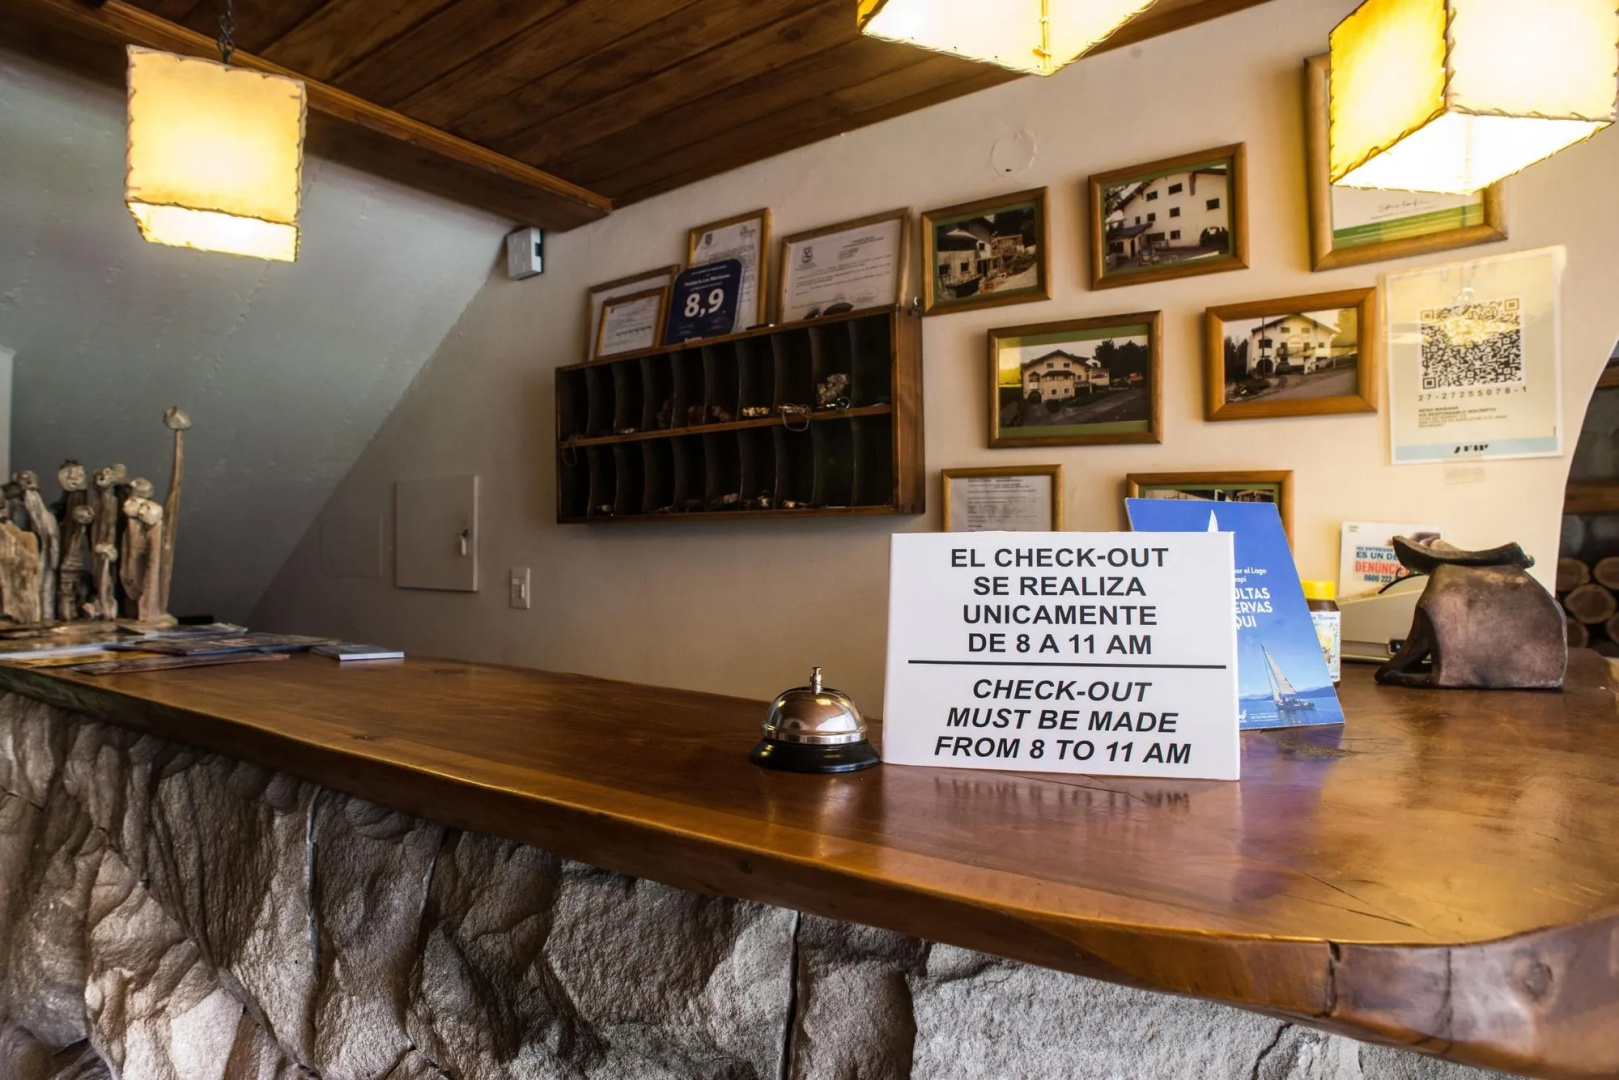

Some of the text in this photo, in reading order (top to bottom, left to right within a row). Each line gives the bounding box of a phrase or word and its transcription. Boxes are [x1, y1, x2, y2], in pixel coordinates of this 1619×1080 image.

[684, 288, 724, 318] 8,9
[951, 547, 1169, 568] EL CHECK-OUT
[1356, 551, 1368, 559] ES
[1243, 566, 1250, 574] el
[1250, 566, 1267, 576] Lago
[973, 576, 1147, 597] SE REALIZA
[963, 604, 1157, 626] UNICAMENTE
[1235, 601, 1273, 614] ERVAS
[1236, 615, 1257, 631] QUI
[968, 632, 1152, 655] DE 8 A 11 AM
[973, 678, 1153, 702] CHECK-OUT
[946, 707, 1179, 733] MUST BE MADE
[934, 735, 1192, 764] FROM 8 TO 11 AM
